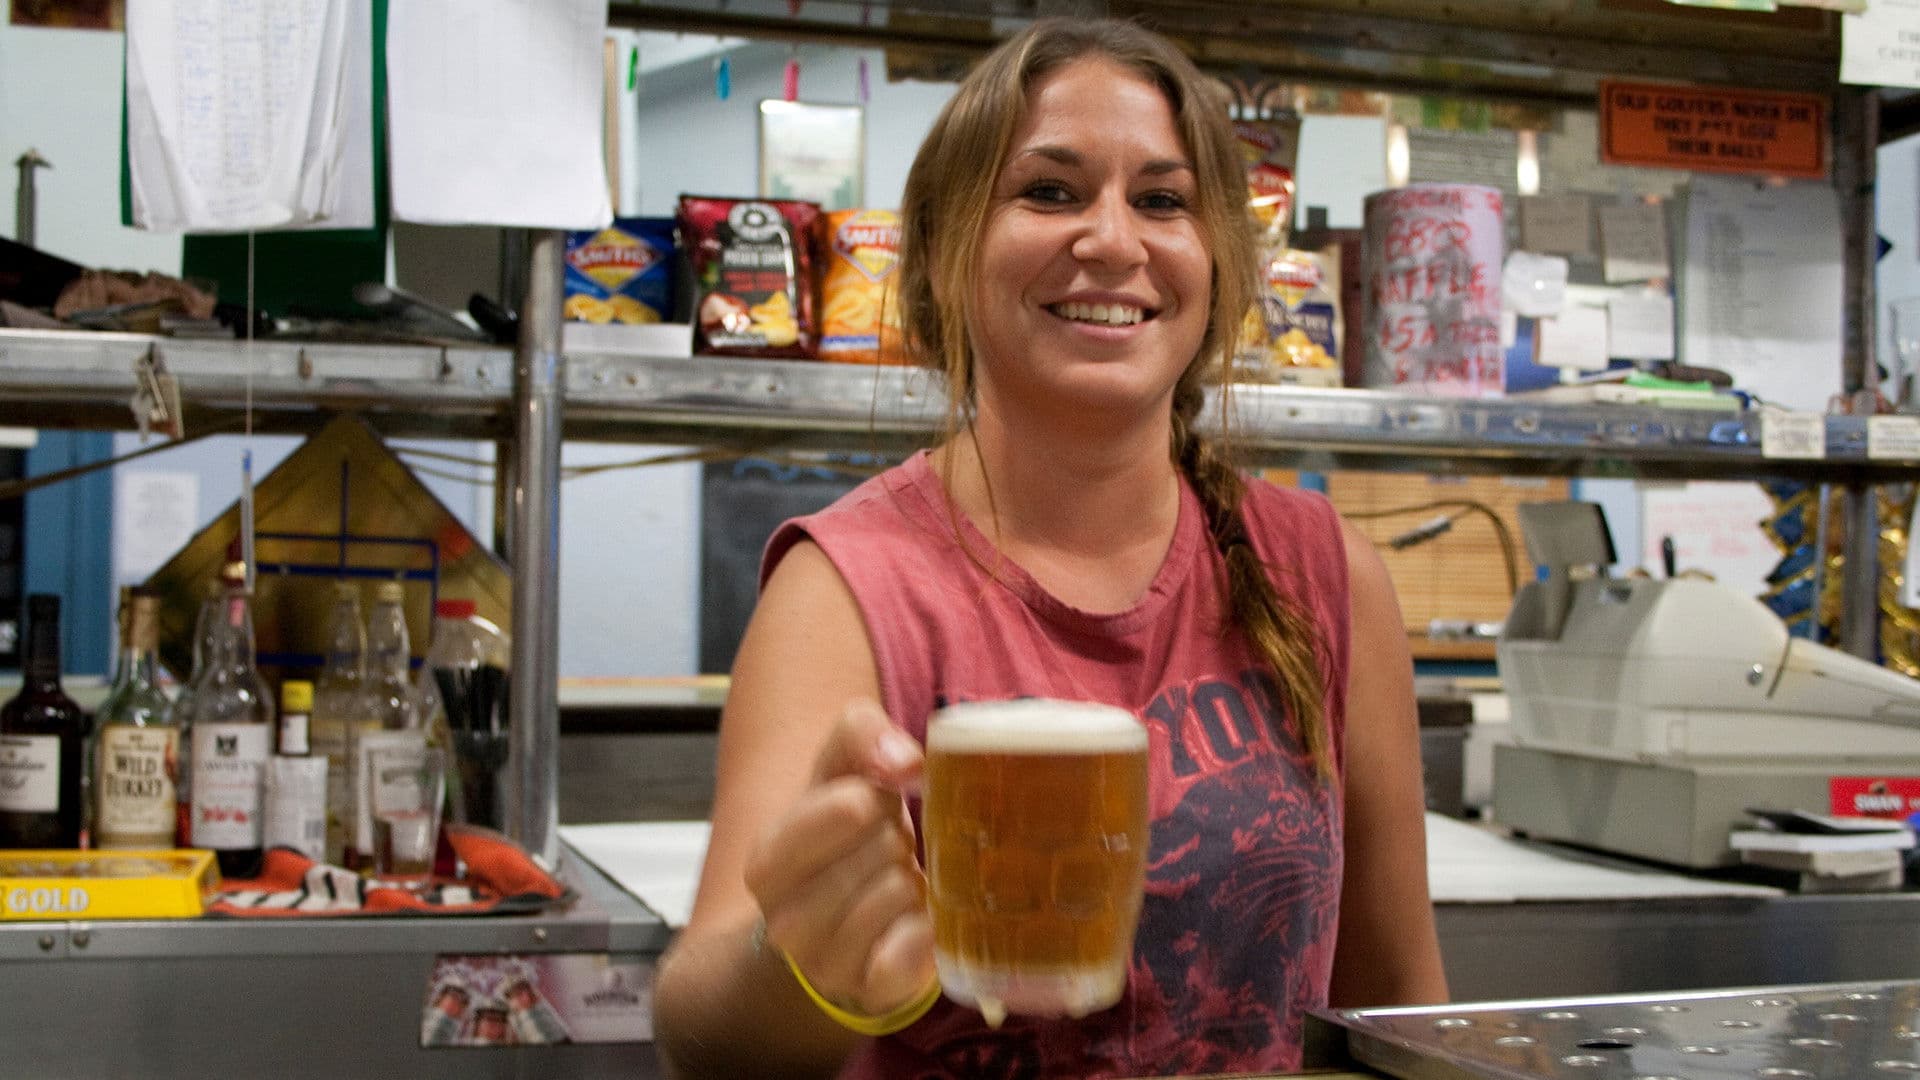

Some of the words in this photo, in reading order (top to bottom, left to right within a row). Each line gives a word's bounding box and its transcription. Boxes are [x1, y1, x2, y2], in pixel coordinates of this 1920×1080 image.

[115, 754, 157, 777] WILD
[105, 773, 163, 798] TURKEY
[7, 886, 90, 914] GOLD
